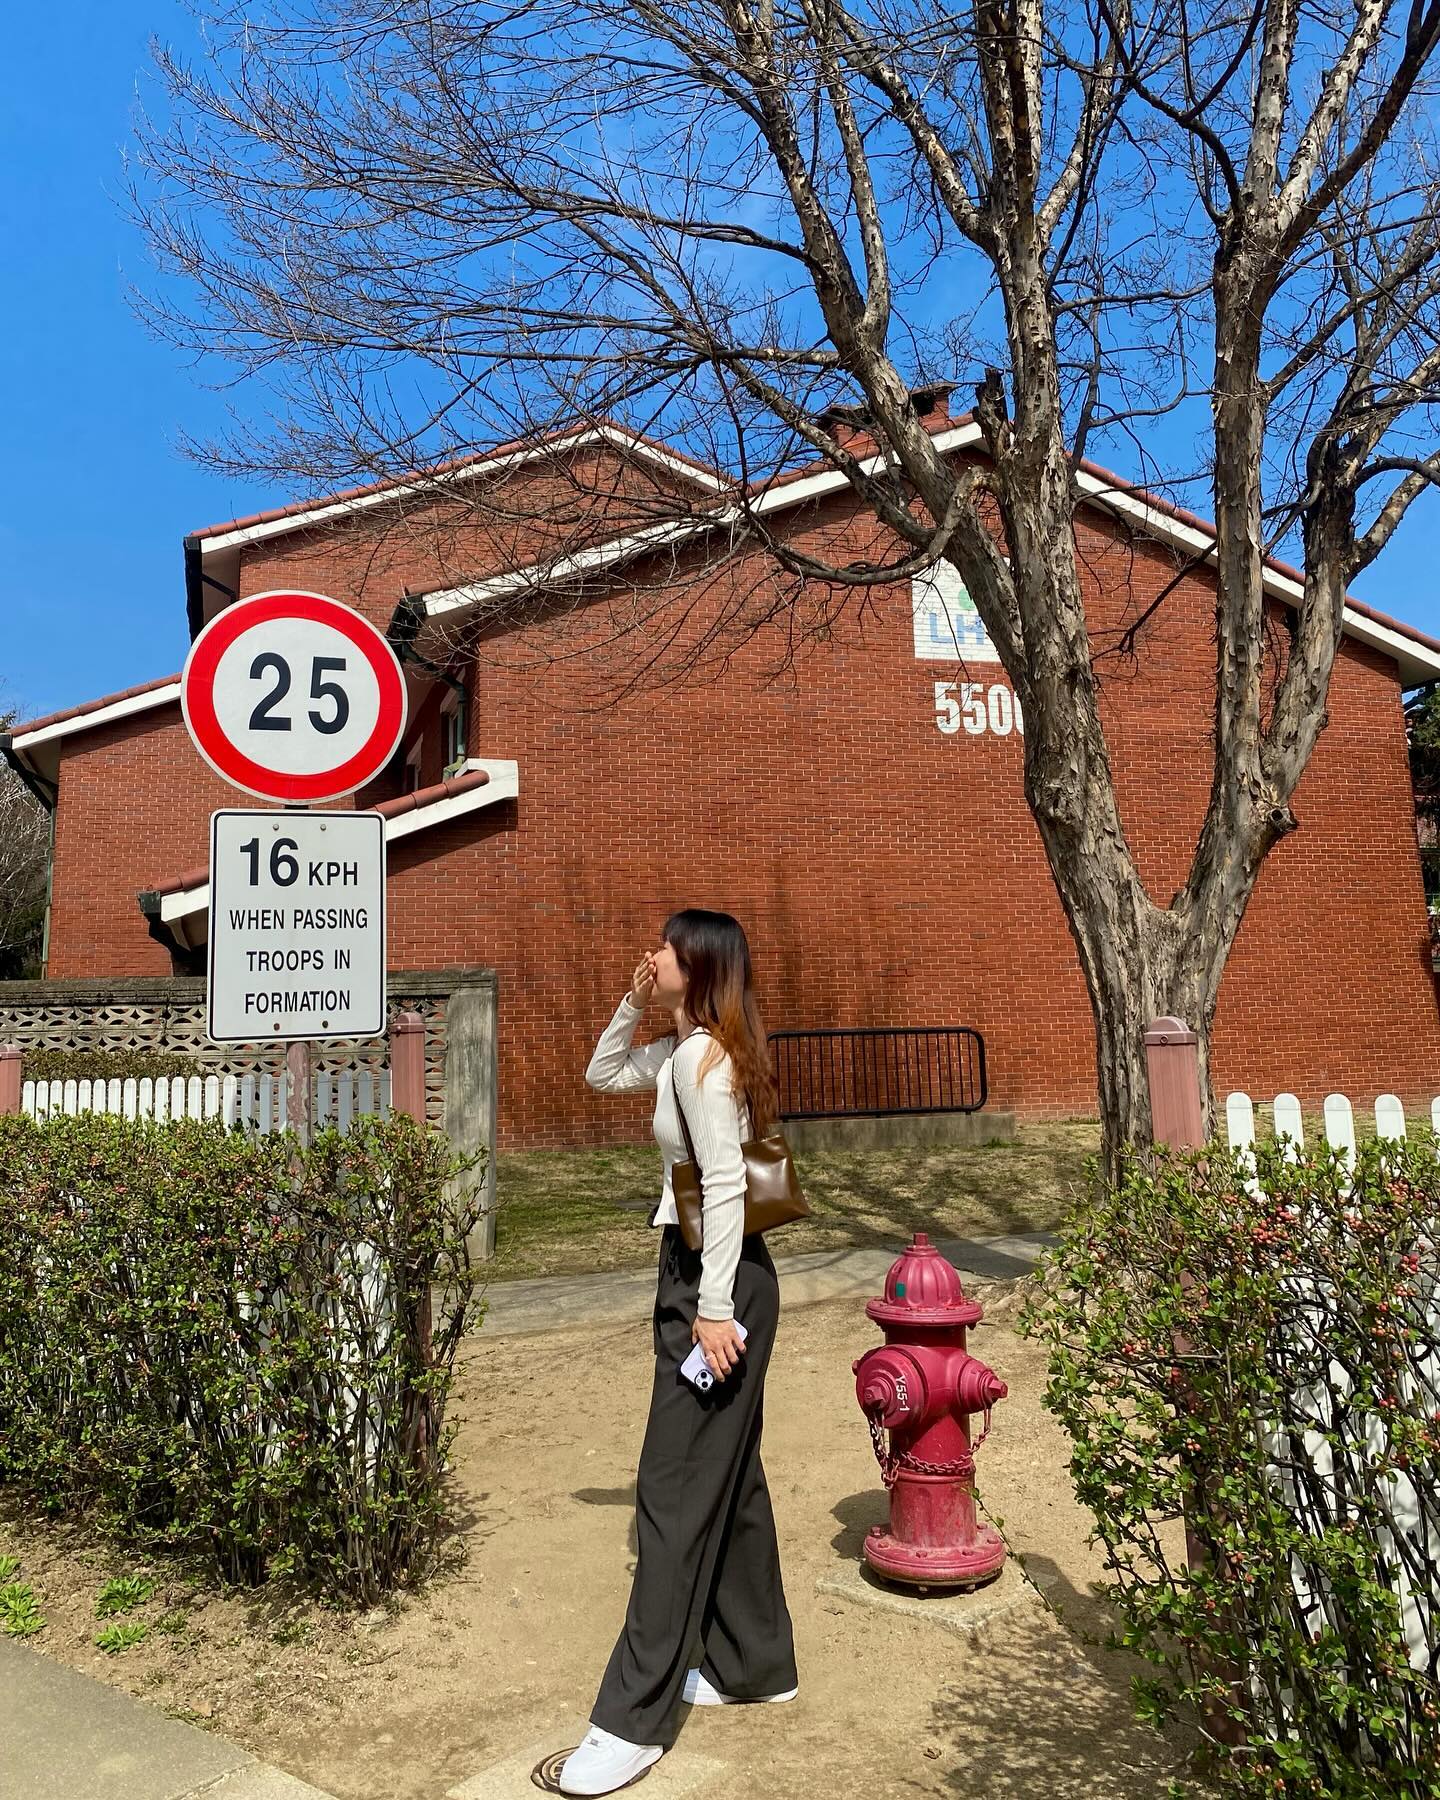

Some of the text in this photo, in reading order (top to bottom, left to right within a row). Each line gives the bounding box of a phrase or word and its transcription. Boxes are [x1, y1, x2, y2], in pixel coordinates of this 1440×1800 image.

[248, 651, 350, 735] 25
[239, 837, 359, 887] 16 KPH
[229, 908, 368, 931] WHEN PASSING
[245, 948, 351, 972] TROOPS IN
[245, 989, 351, 1015] FORMATION
[895, 1374, 910, 1411] Y55-1
